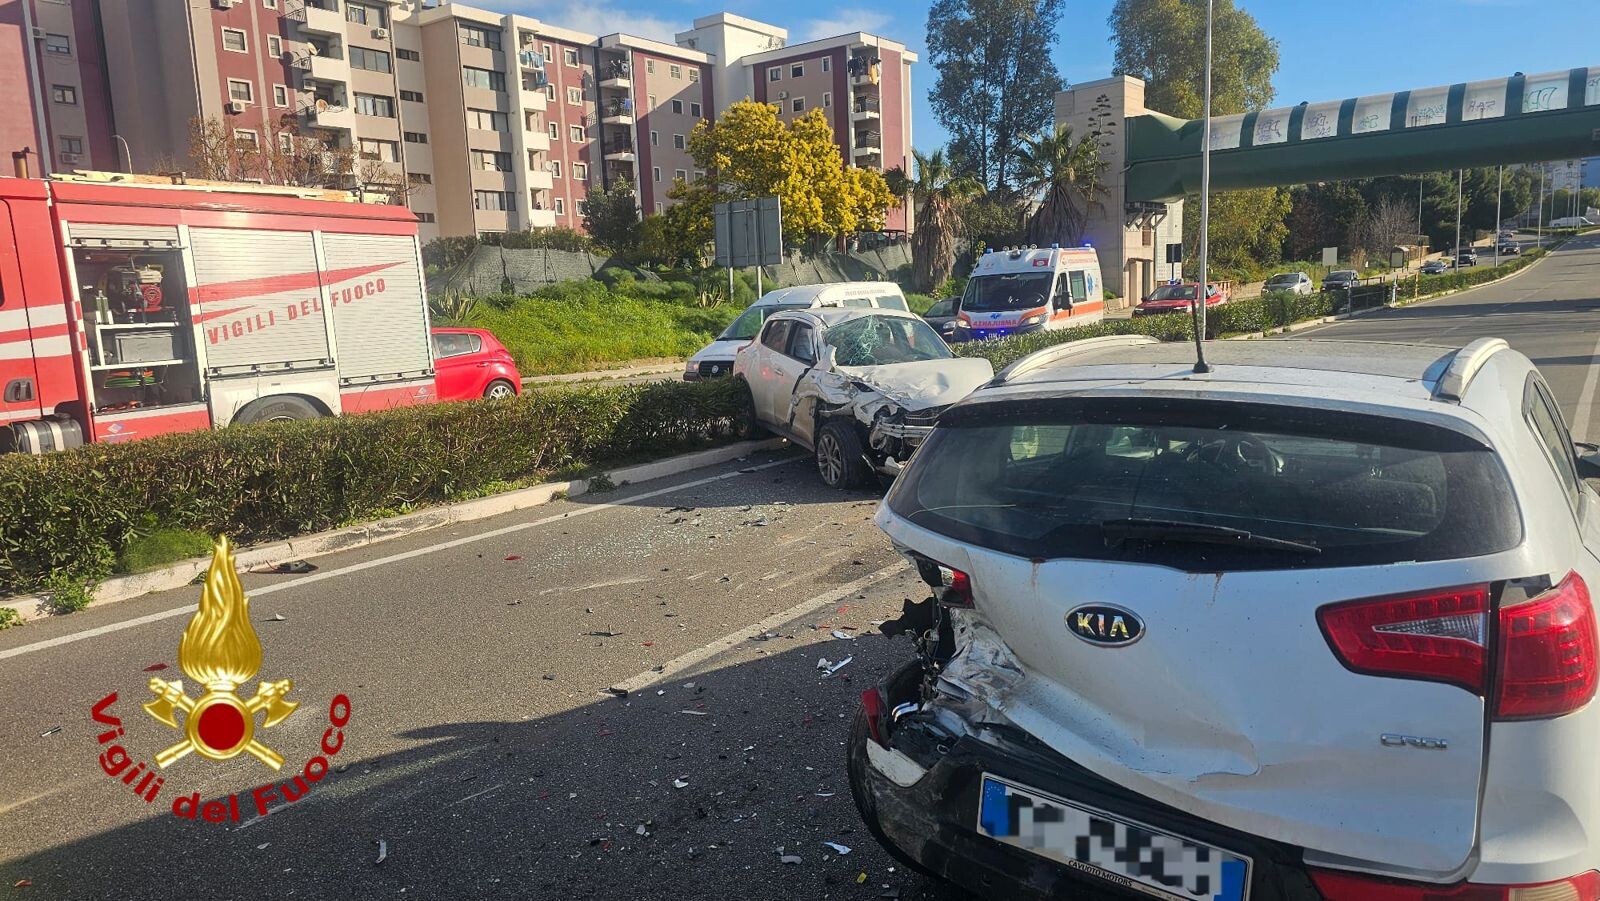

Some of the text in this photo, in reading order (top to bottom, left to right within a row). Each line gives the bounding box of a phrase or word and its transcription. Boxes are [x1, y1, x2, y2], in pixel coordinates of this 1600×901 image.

[207, 278, 386, 344] VIGILI DEL FUOCO
[1076, 611, 1130, 638] KIA
[1068, 860, 1133, 887] CAVUOTO MOTORS
